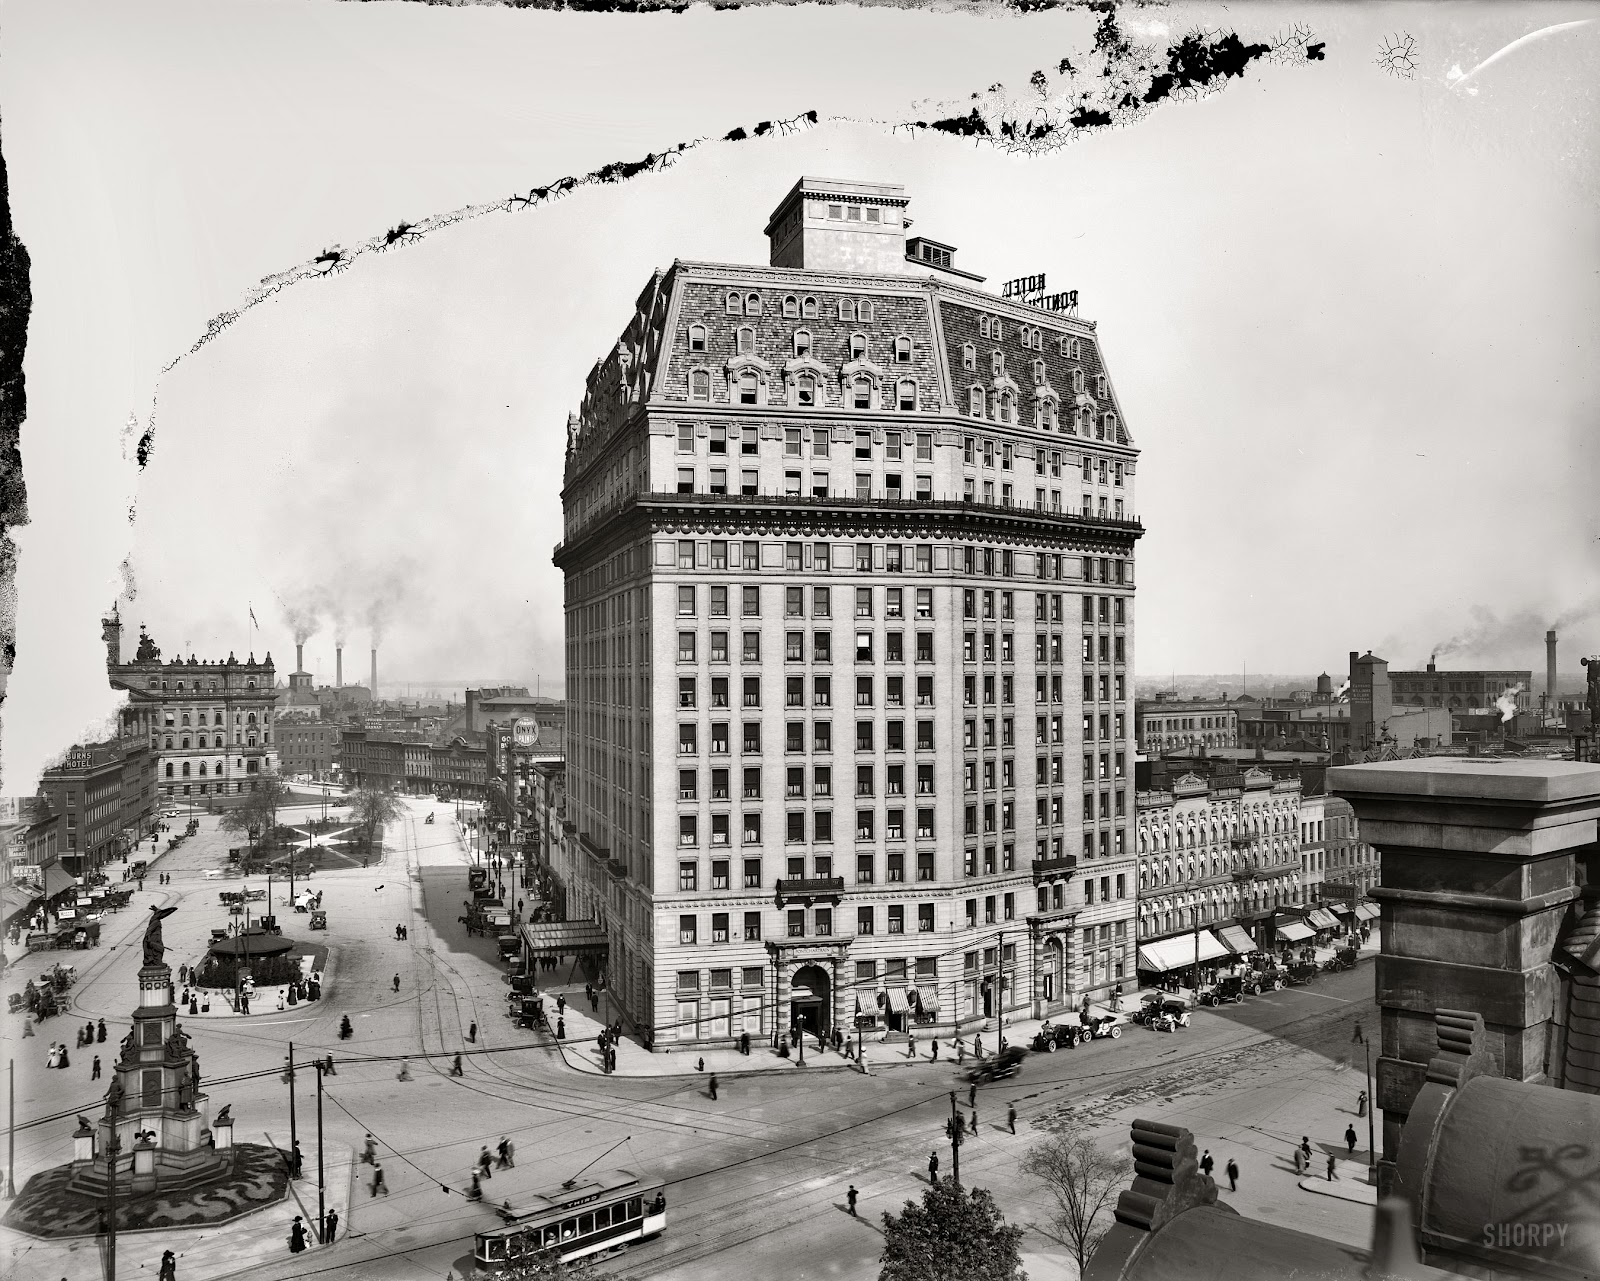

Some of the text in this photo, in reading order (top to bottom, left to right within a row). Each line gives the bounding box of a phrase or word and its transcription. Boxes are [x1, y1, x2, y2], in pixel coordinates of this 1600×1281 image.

[516, 725, 536, 735] ONYX
[518, 734, 535, 744] PAINTS
[66, 752, 92, 760] BURNS
[66, 760, 92, 768] HOTEL
[1217, 765, 1236, 774] HOTEL
[1210, 778, 1244, 787] METROPOLE
[497, 822, 506, 831] 42
[1326, 887, 1354, 897] MISFIT
[567, 1195, 597, 1207] THIRD
